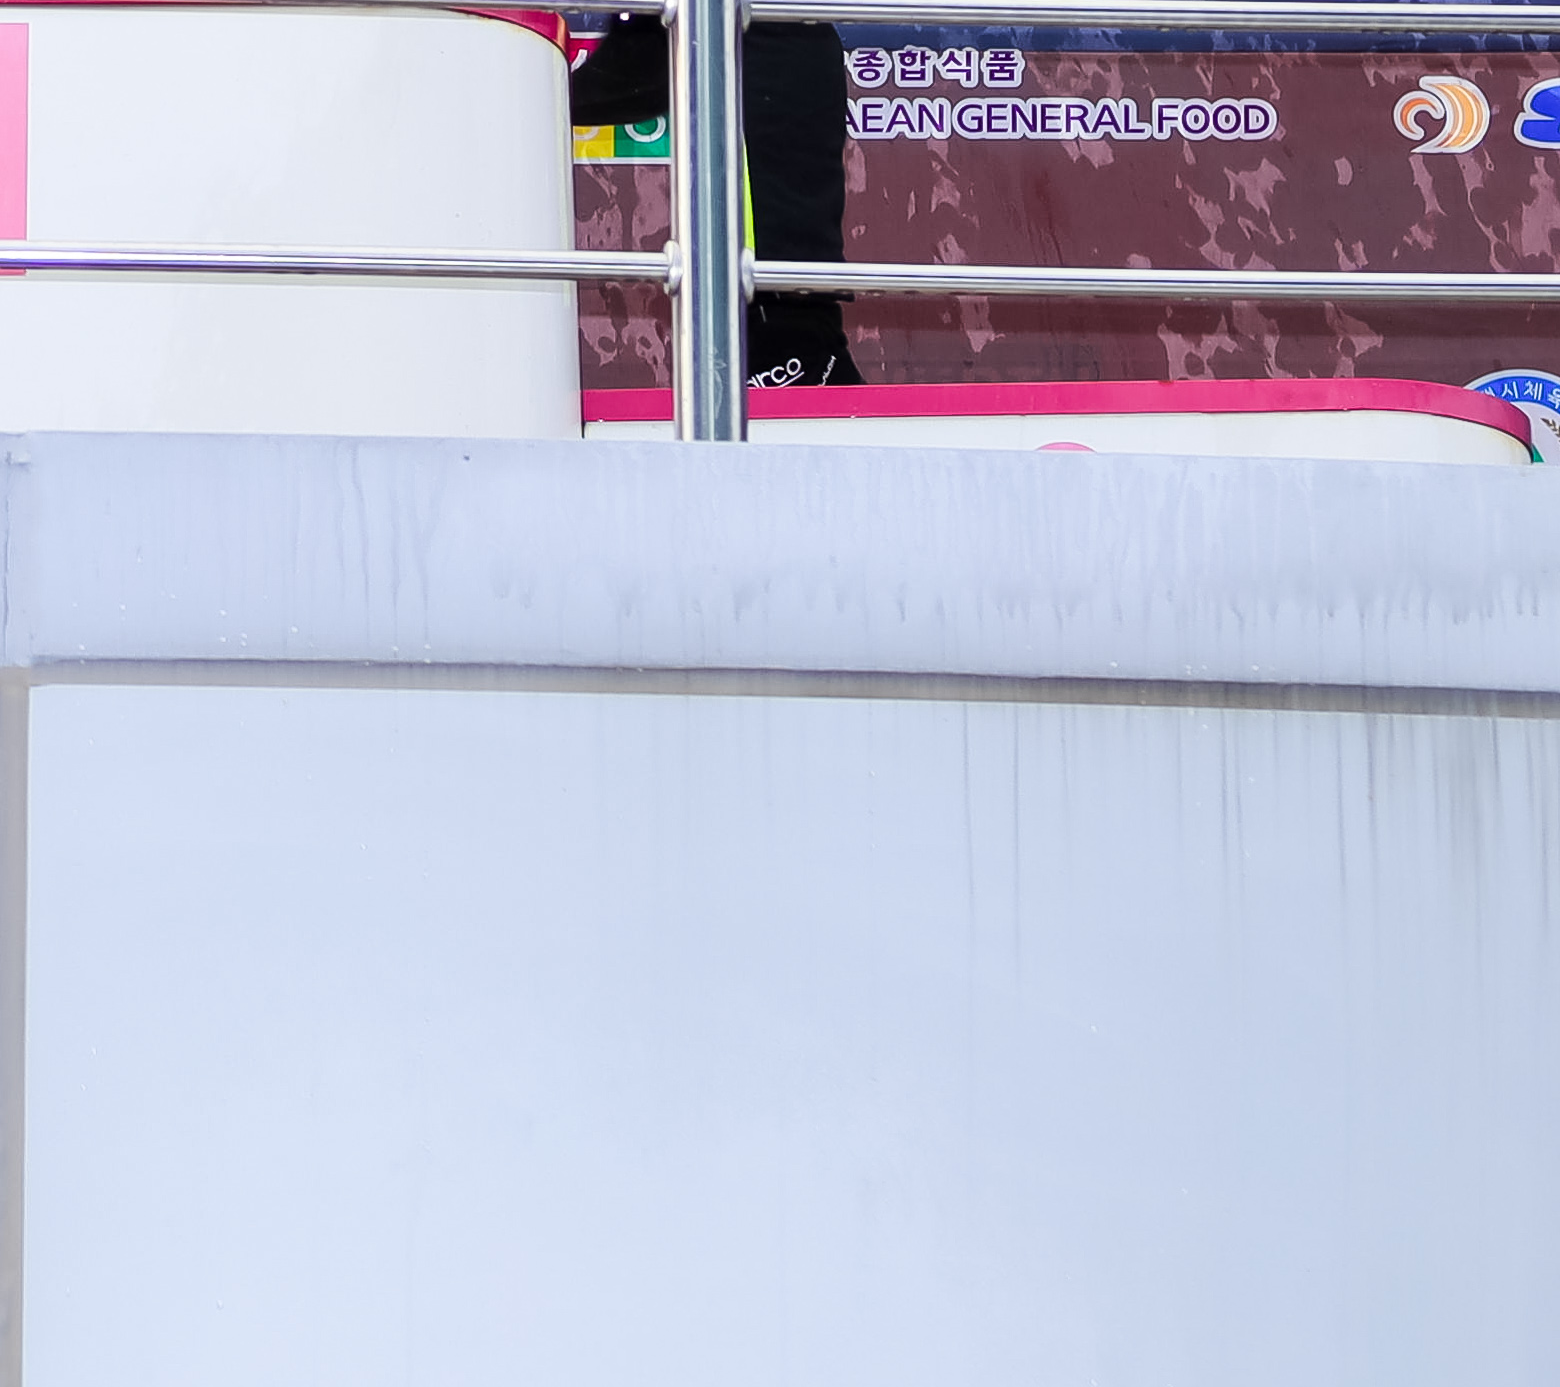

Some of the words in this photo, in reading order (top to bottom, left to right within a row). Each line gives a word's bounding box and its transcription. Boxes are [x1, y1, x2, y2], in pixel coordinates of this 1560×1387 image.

[845, 50, 1020, 82] 종합식품
[957, 103, 1144, 134] GENERAL
[1158, 103, 1271, 135] FOOD
